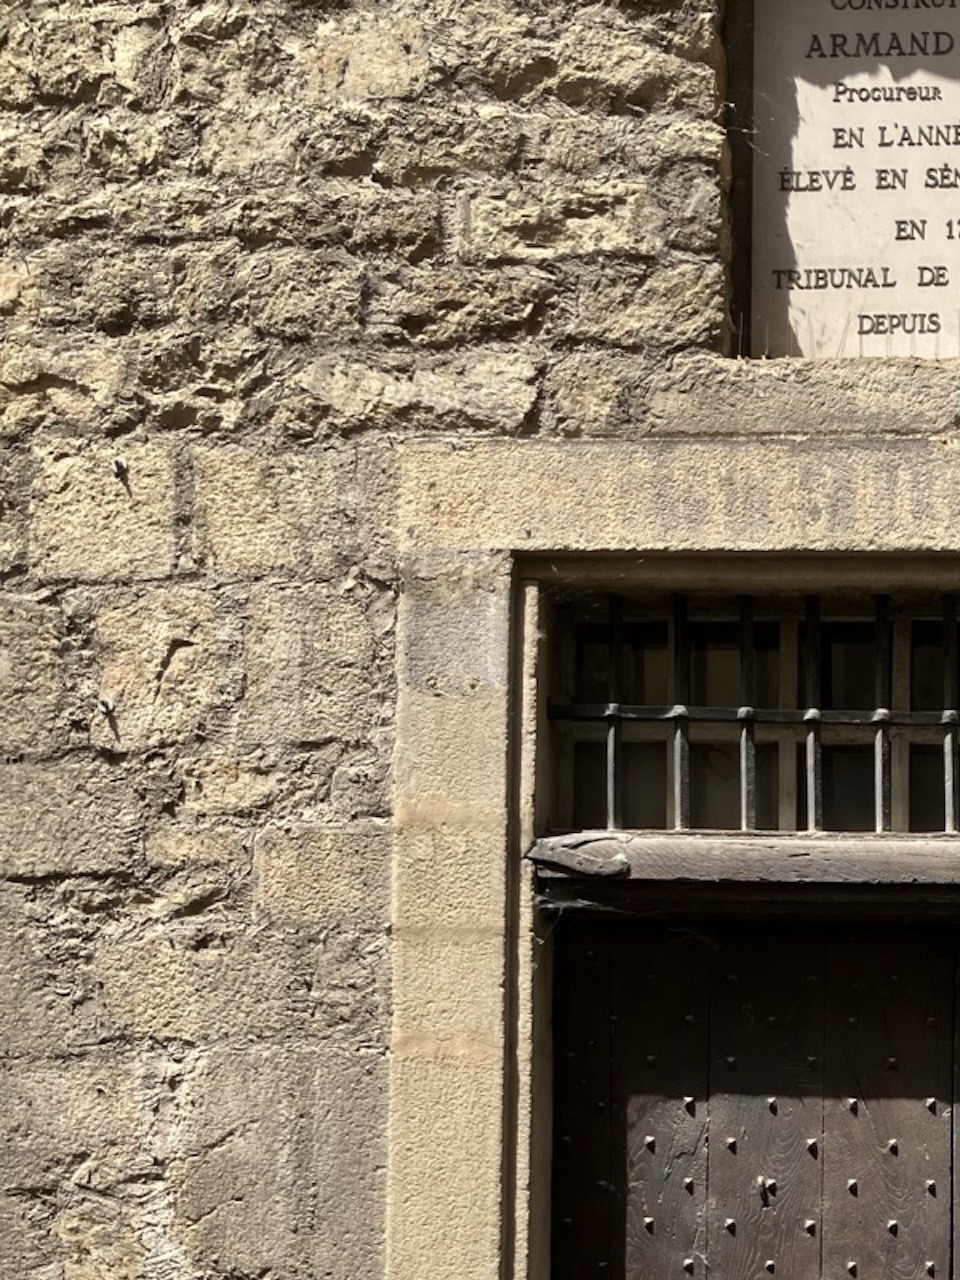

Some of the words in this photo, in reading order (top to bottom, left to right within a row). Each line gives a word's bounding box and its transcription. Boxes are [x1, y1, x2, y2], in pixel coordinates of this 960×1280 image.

[805, 32, 955, 59] ARMAND
[833, 127, 864, 148] EN
[778, 166, 856, 191] ÉLEVÉ
[876, 169, 908, 190] EN
[895, 219, 927, 240] EN
[772, 266, 896, 290] TRIBUNAL
[917, 266, 949, 286] DE
[857, 313, 941, 335] DEPUIS
